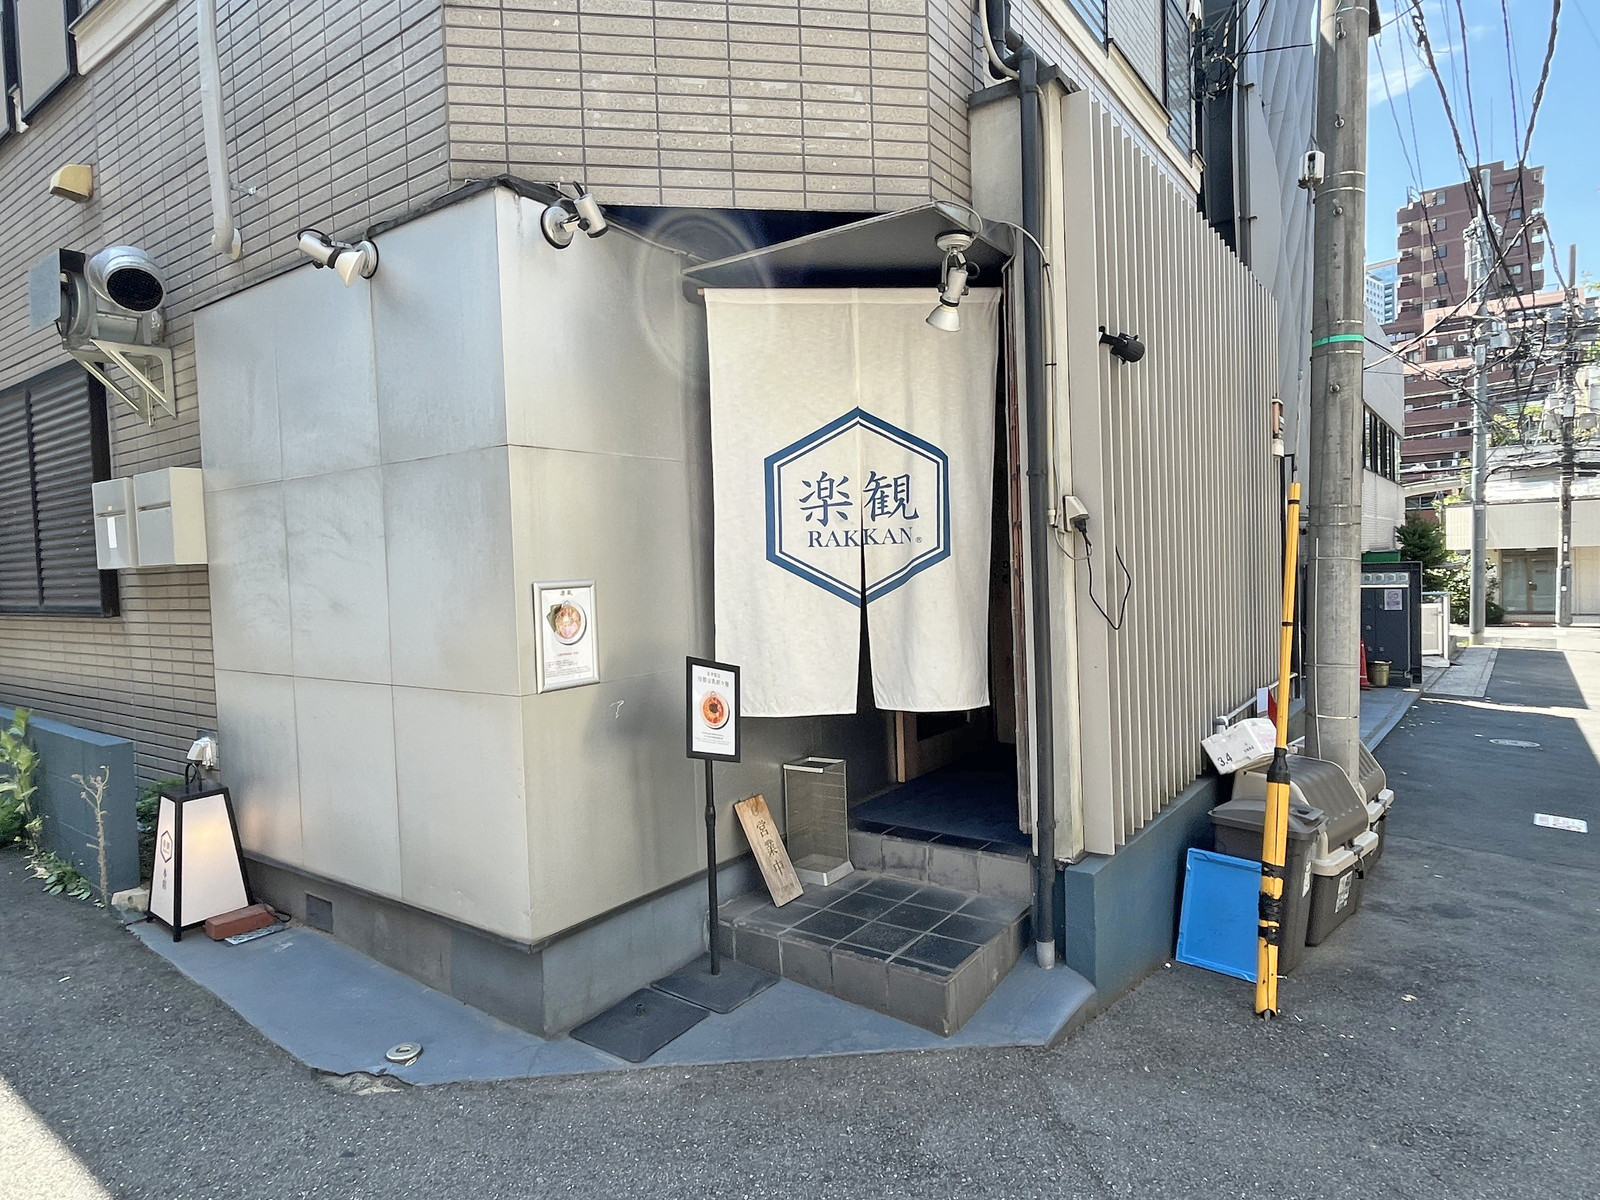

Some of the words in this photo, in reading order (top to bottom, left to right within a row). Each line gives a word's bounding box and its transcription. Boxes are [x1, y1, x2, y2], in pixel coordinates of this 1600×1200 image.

[799, 471, 919, 527] 楽観
[757, 820, 785, 876] 営業中
